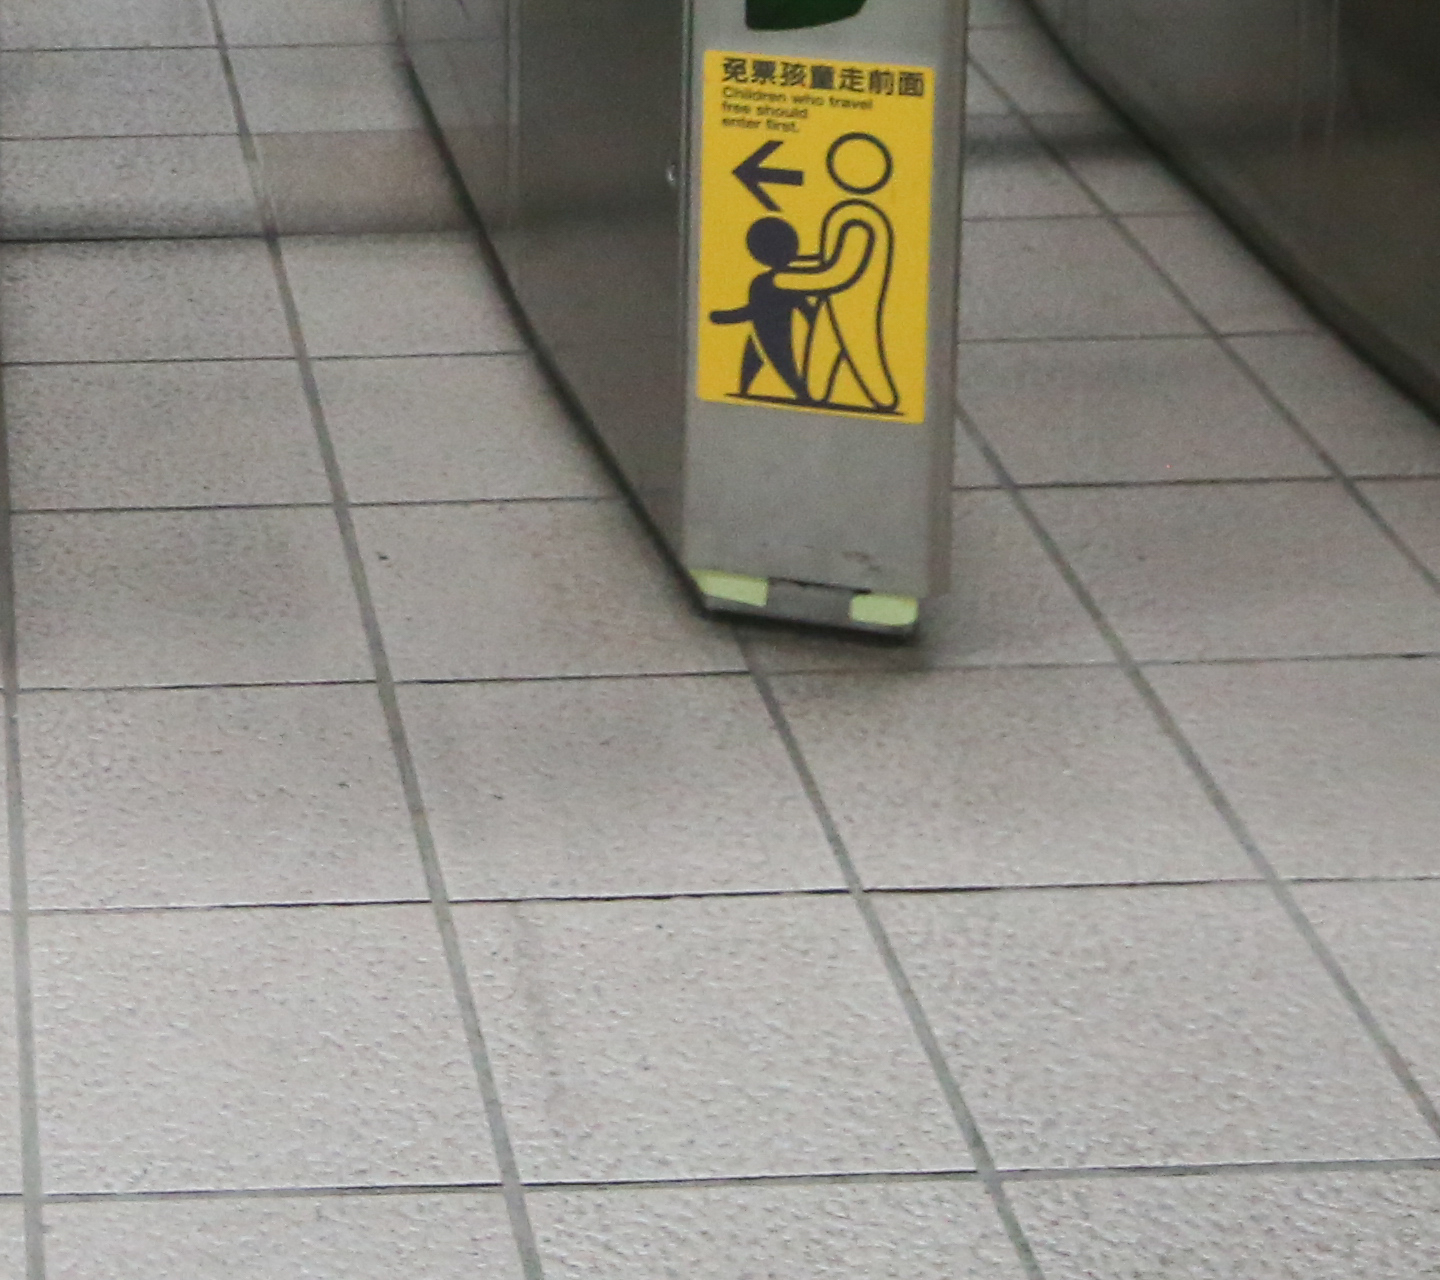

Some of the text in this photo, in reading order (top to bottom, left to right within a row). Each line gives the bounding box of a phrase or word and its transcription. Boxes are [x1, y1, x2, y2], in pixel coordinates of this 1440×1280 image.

[722, 57, 924, 97] 免票孩童走前面
